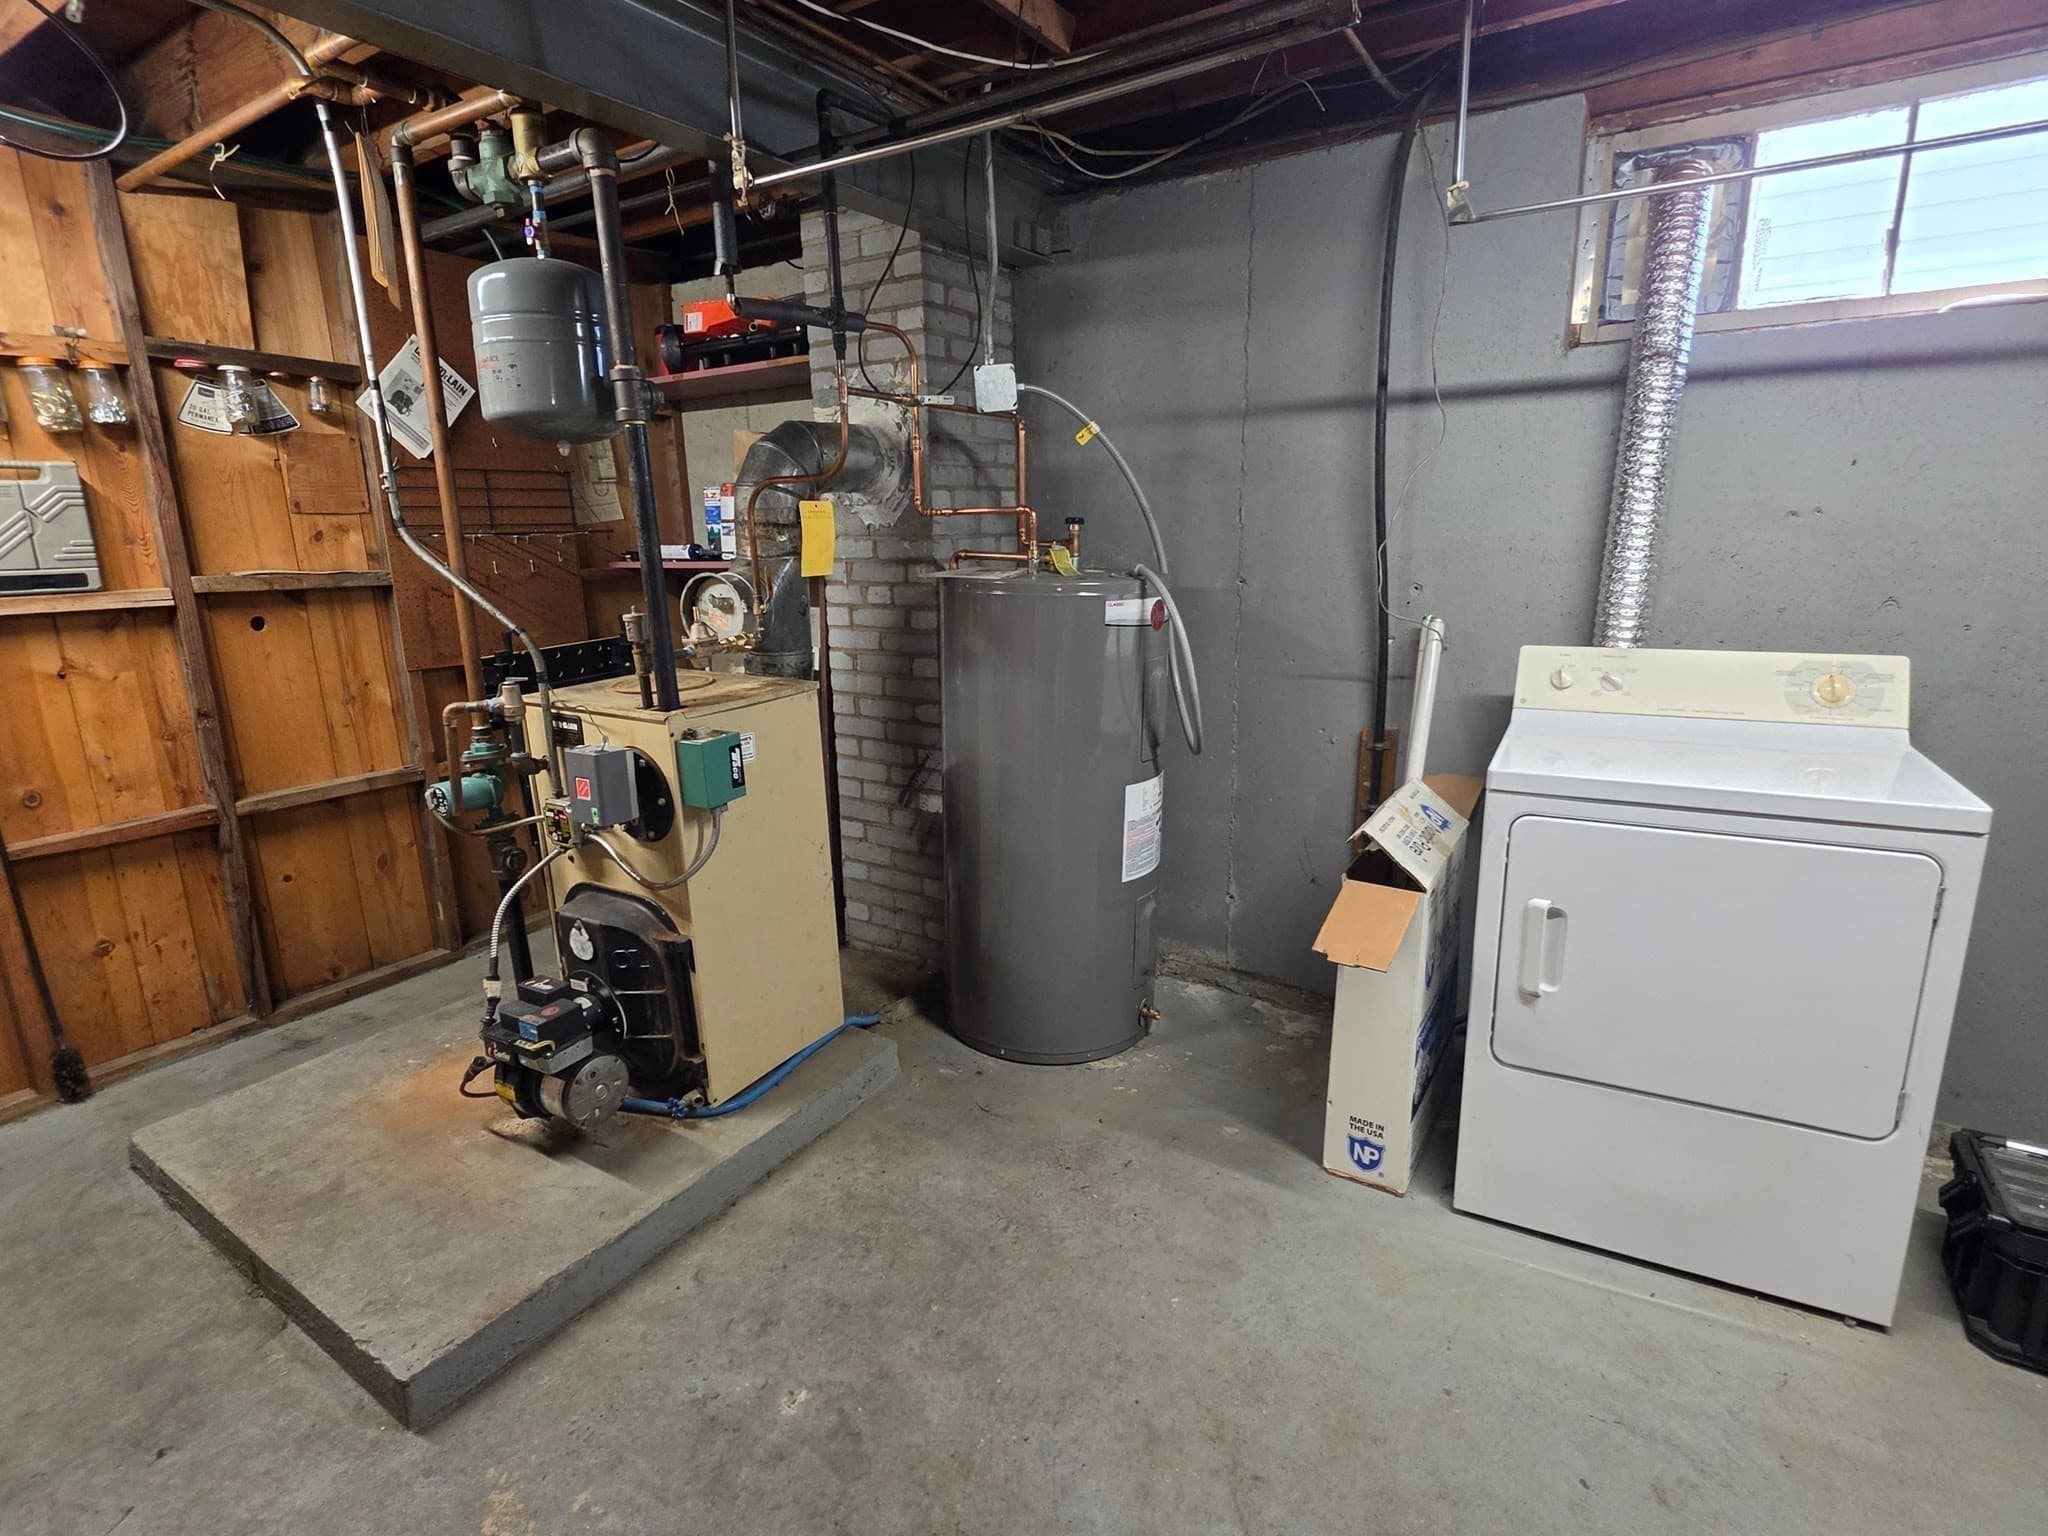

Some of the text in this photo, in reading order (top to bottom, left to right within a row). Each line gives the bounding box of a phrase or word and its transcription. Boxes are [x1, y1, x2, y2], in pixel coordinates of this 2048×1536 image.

[1349, 1115, 1384, 1132] MADE IN
[1349, 1122, 1384, 1139] THE USA
[1353, 1142, 1380, 1165] NP
